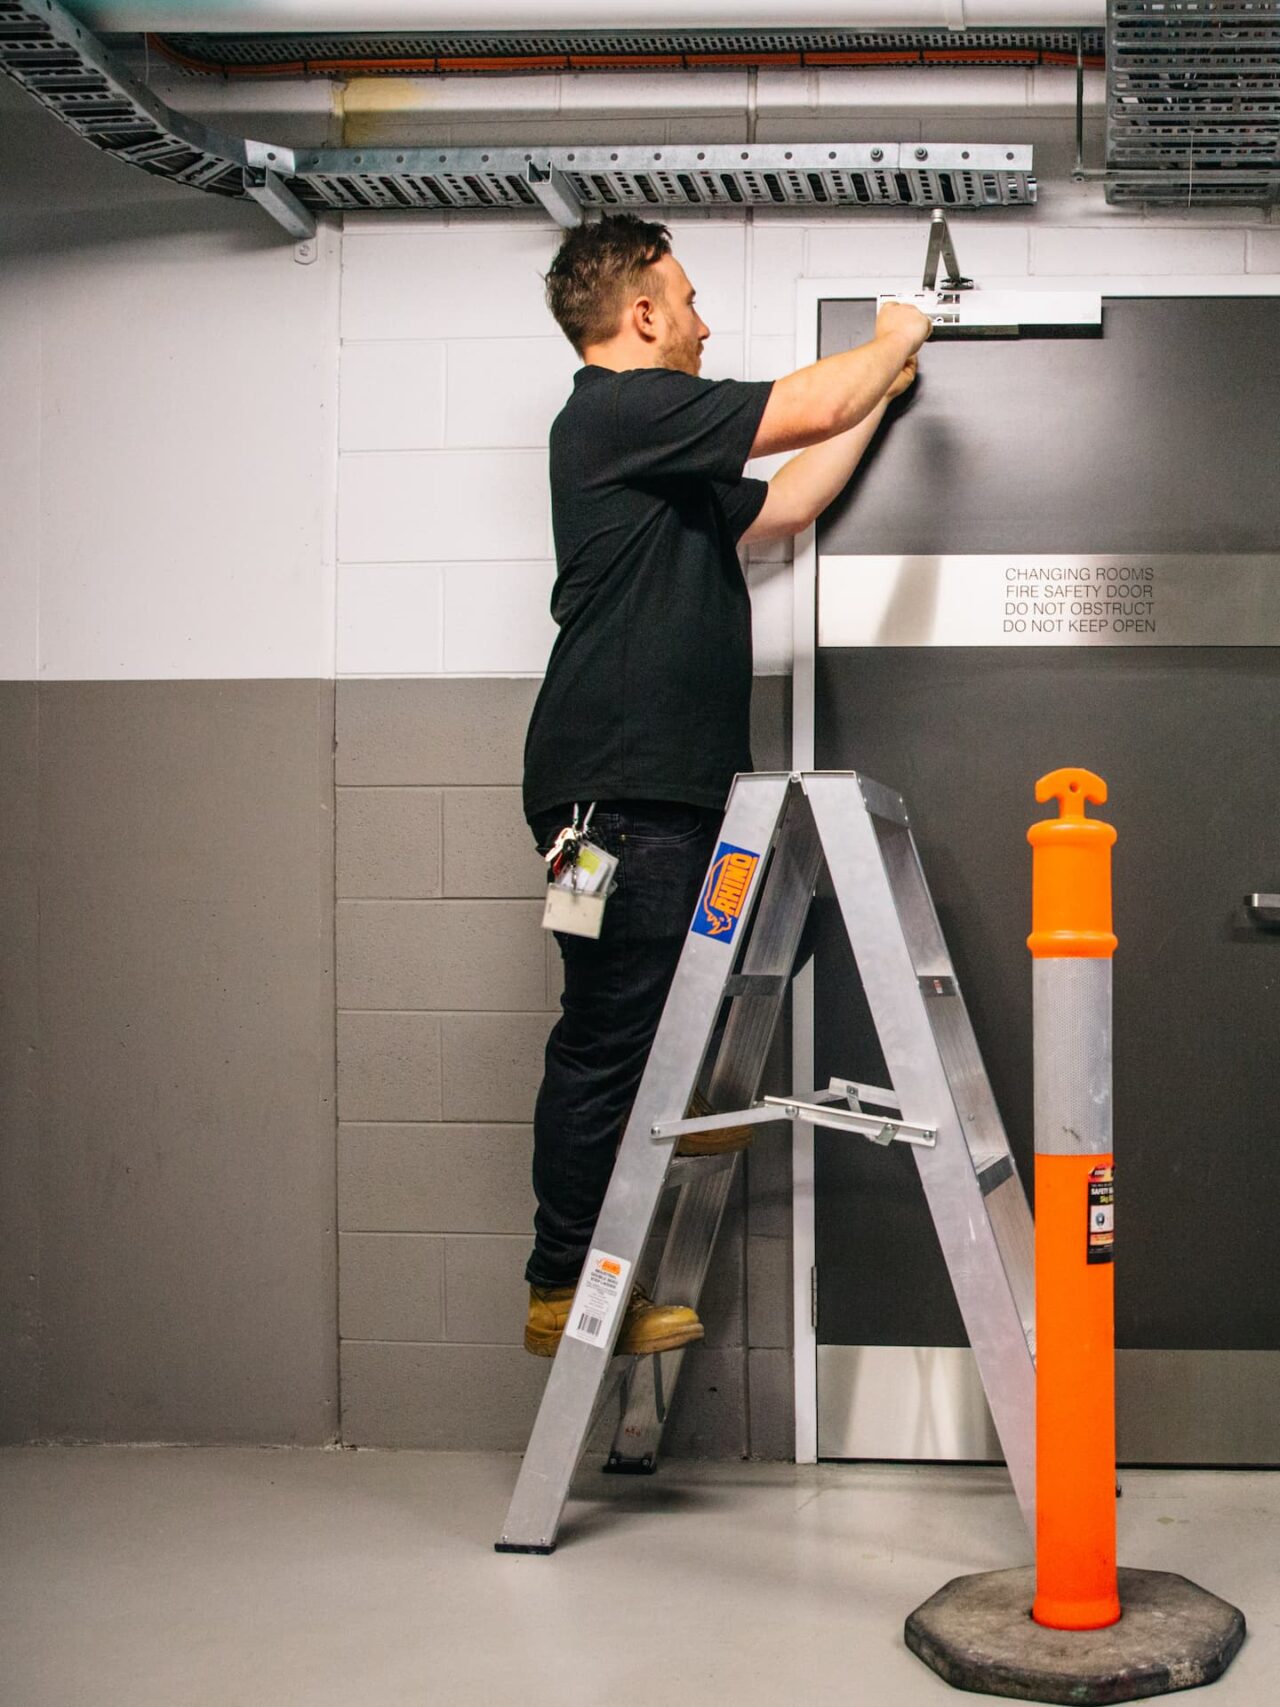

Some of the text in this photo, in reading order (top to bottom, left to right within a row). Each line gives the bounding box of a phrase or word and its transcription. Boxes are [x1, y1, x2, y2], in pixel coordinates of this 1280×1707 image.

[1005, 567, 1154, 581] CHANGING ROOMS
[1006, 584, 1153, 598] FIRE SAFETY DOOR
[1004, 602, 1155, 615] DO NOT OBSTRUCT
[1003, 619, 1156, 633] DO NOT KEEP OPEN
[714, 852, 753, 915] RHINO
